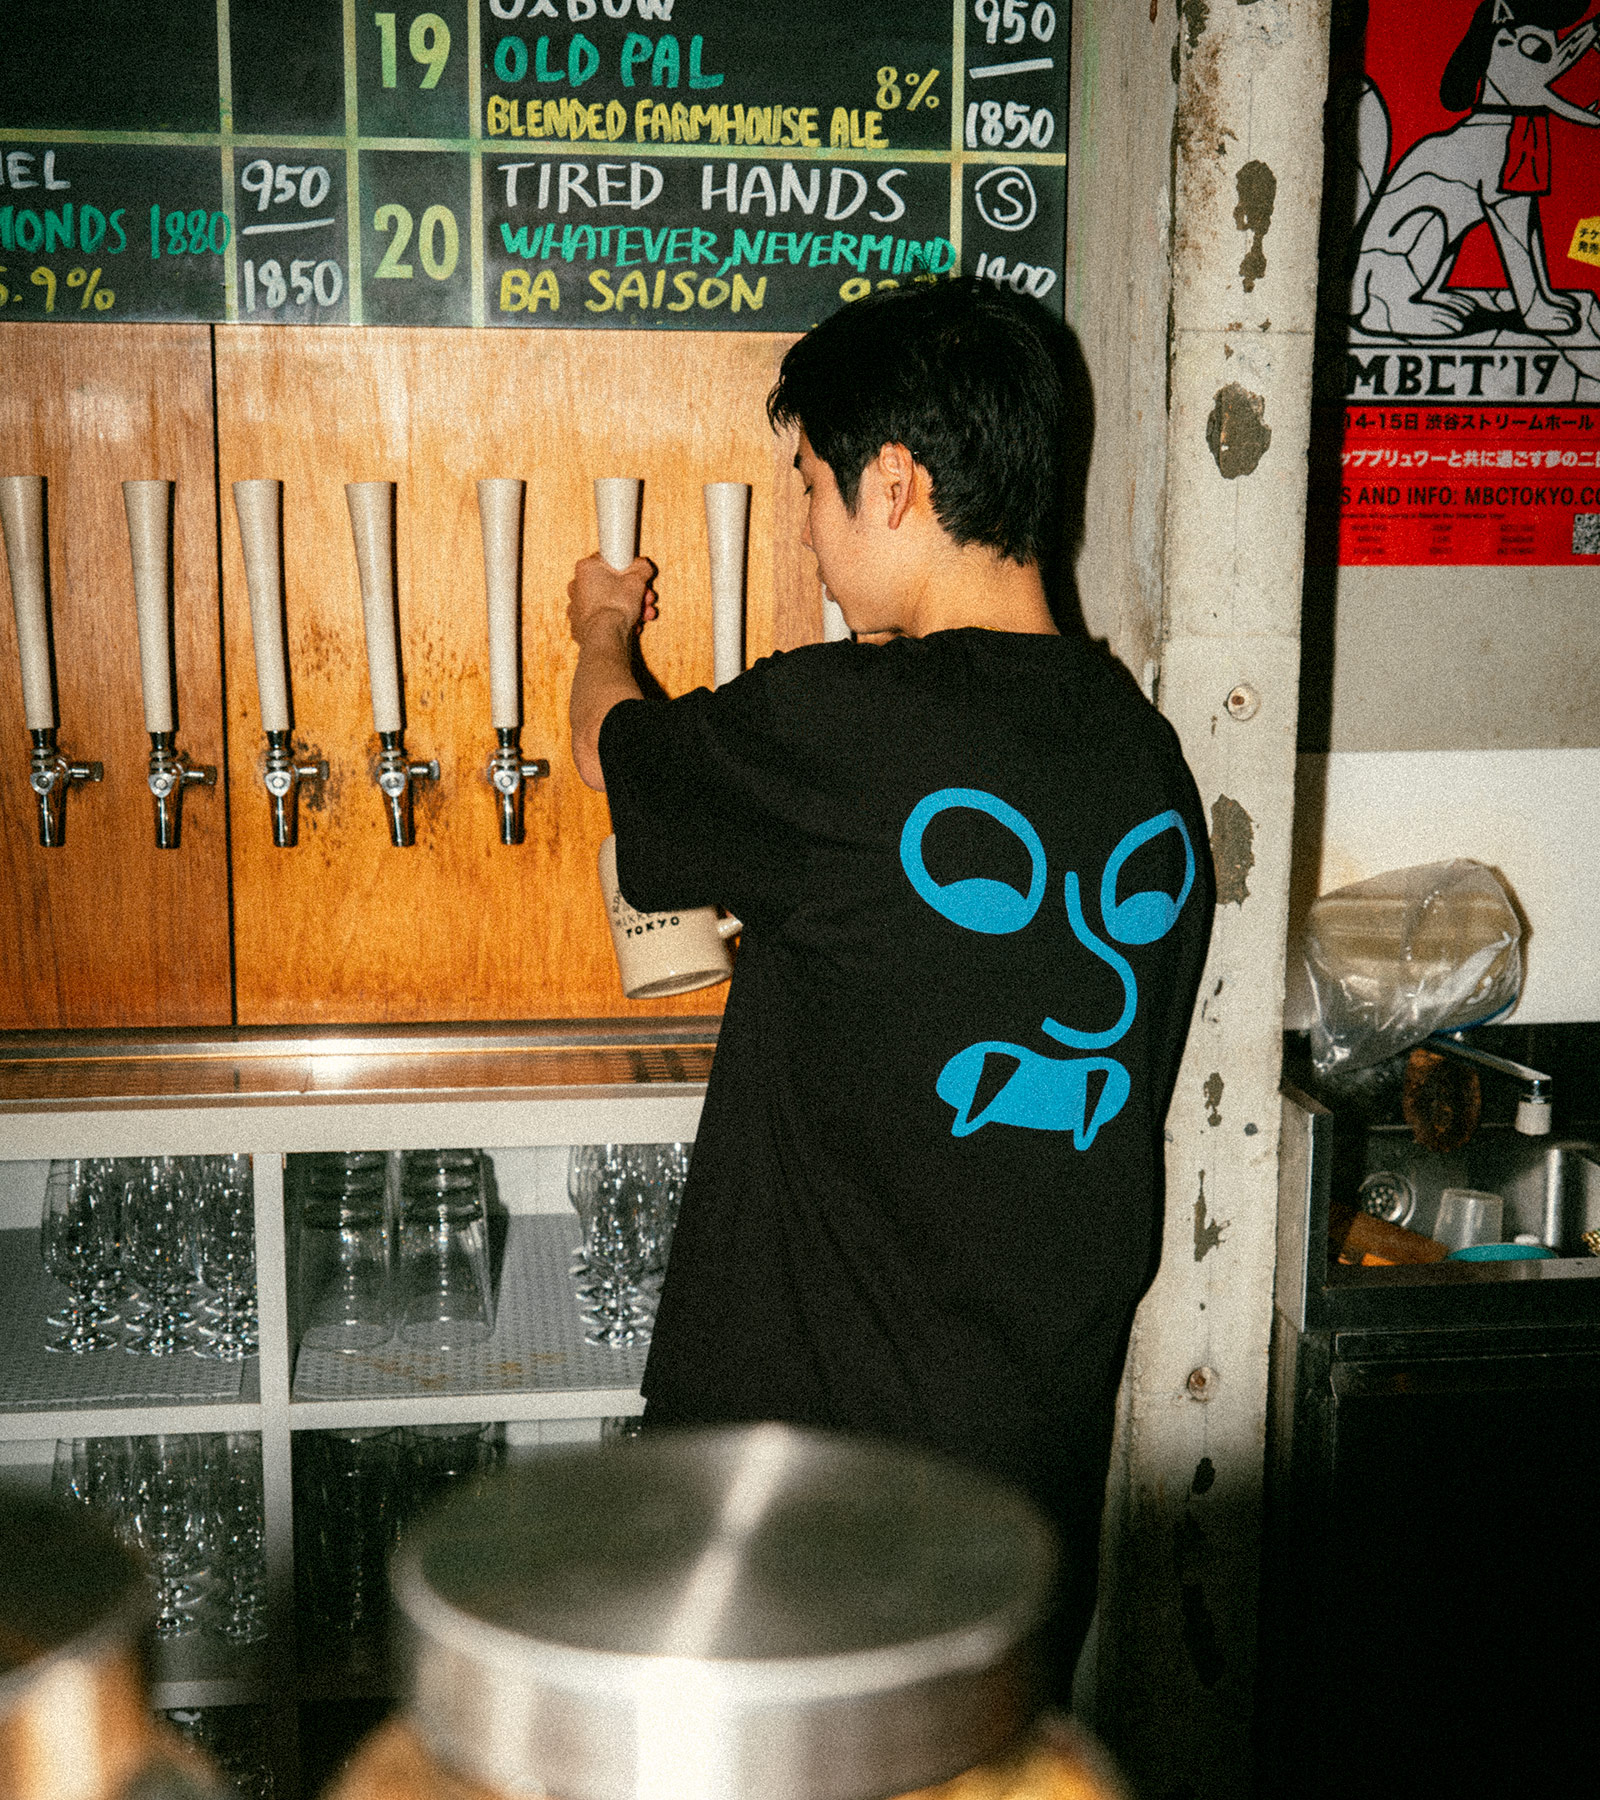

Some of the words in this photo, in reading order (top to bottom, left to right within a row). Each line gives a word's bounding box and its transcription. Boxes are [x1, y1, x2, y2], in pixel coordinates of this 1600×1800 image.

[974, 0, 1056, 44] 950
[374, 12, 451, 89] 19
[494, 33, 600, 88] OLD
[620, 32, 724, 89] PAL
[876, 66, 940, 110] 8%
[487, 95, 627, 142] BLENDED
[634, 98, 821, 148] FARMHOUSE
[830, 106, 889, 149] ALE
[965, 101, 1055, 149] 1850
[0, 150, 71, 190] EL
[241, 159, 330, 212] 950
[498, 162, 663, 213] TIRED
[702, 163, 907, 222] HANDS
[150, 204, 232, 259] 1880
[373, 204, 460, 281] 20
[244, 259, 342, 313] 1850
[500, 269, 560, 312] BA
[584, 269, 767, 312] SAISON
[1425, 413, 1595, 432] 渋谷ストリームホール
[1358, 487, 1400, 505] AND
[626, 916, 680, 938] TOKYO
